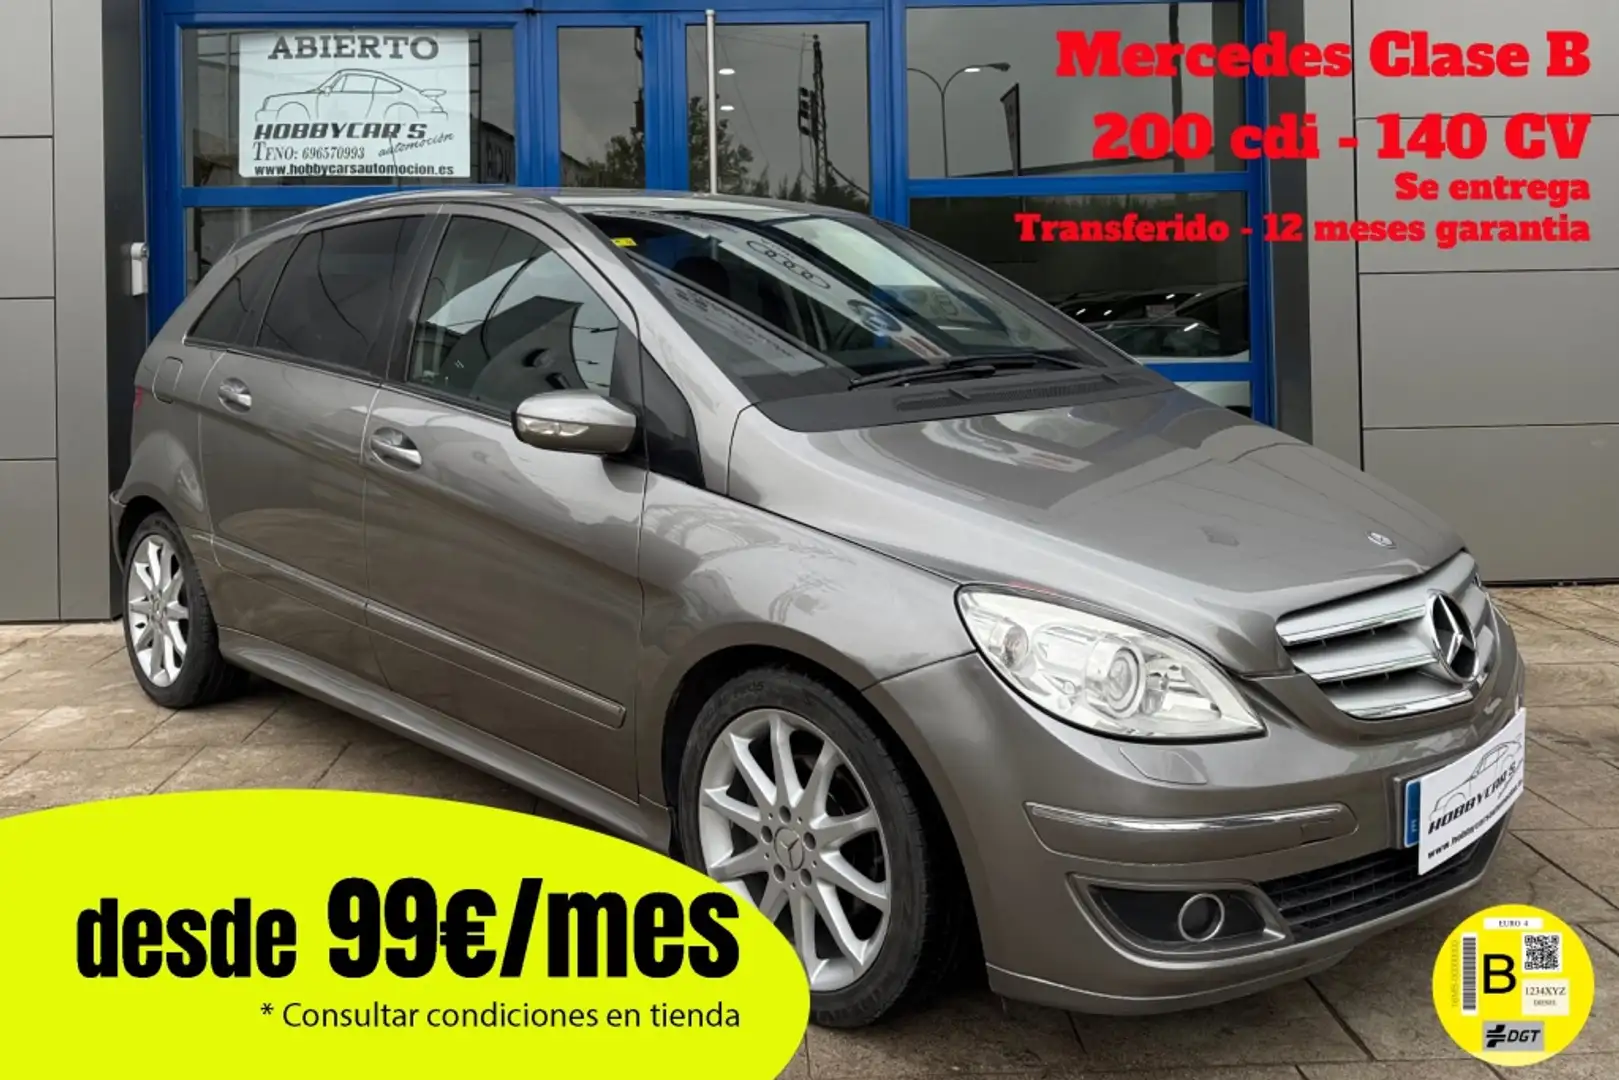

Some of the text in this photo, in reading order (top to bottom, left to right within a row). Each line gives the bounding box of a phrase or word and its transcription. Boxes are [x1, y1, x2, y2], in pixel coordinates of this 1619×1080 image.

[267, 34, 439, 60] ABIERTO
[254, 122, 427, 140] HOBBYCAR'S
[254, 163, 454, 177] www.hobbycarsautomocion.es
